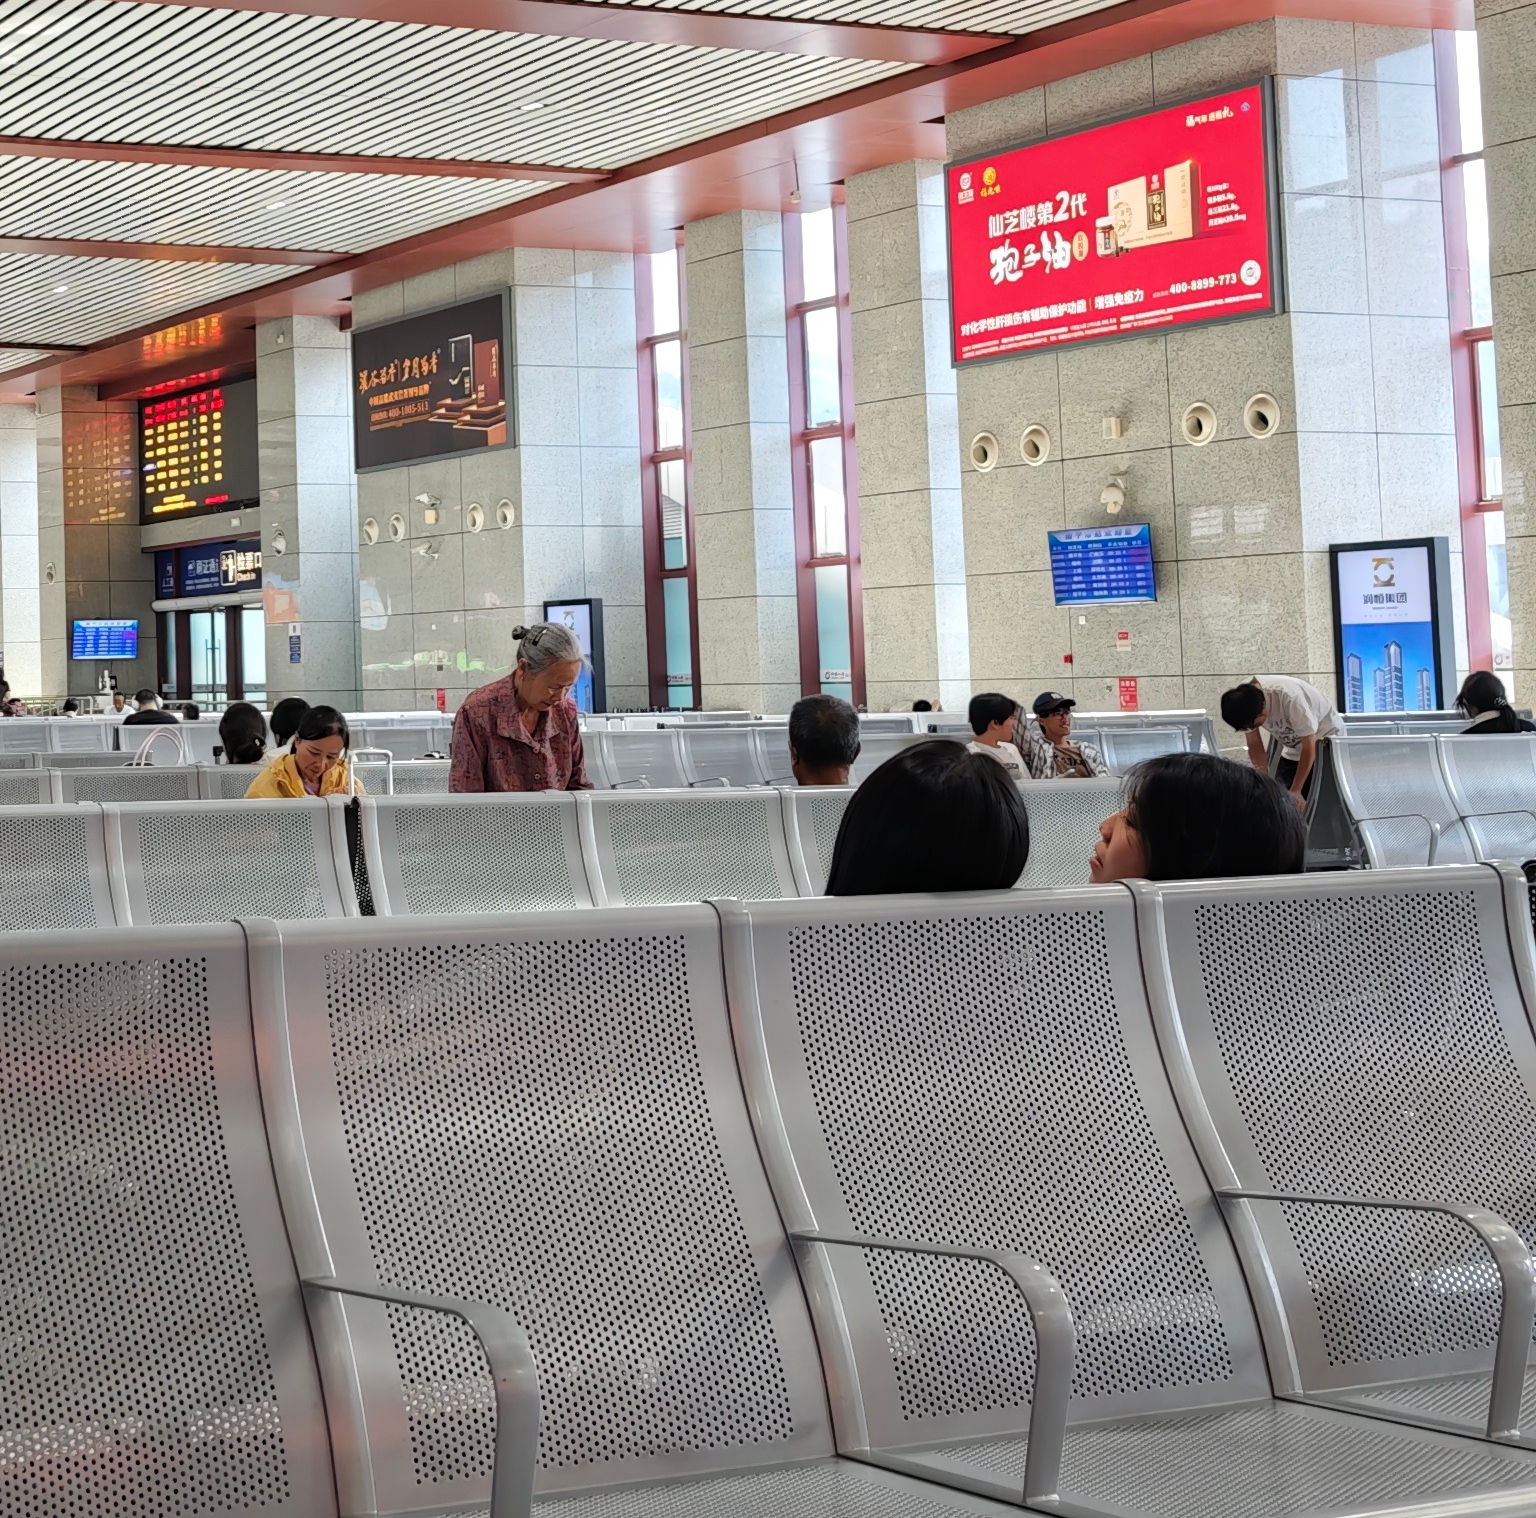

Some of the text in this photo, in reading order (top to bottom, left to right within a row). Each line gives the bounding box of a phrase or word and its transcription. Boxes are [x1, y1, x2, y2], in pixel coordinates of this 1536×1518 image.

[988, 190, 1087, 238] 仙芝楼第2代
[989, 231, 1071, 285] 孢子油
[1169, 273, 1237, 294] 400-8899-773
[1094, 288, 1144, 310] 增强免疫力
[237, 551, 262, 571] 检票口
